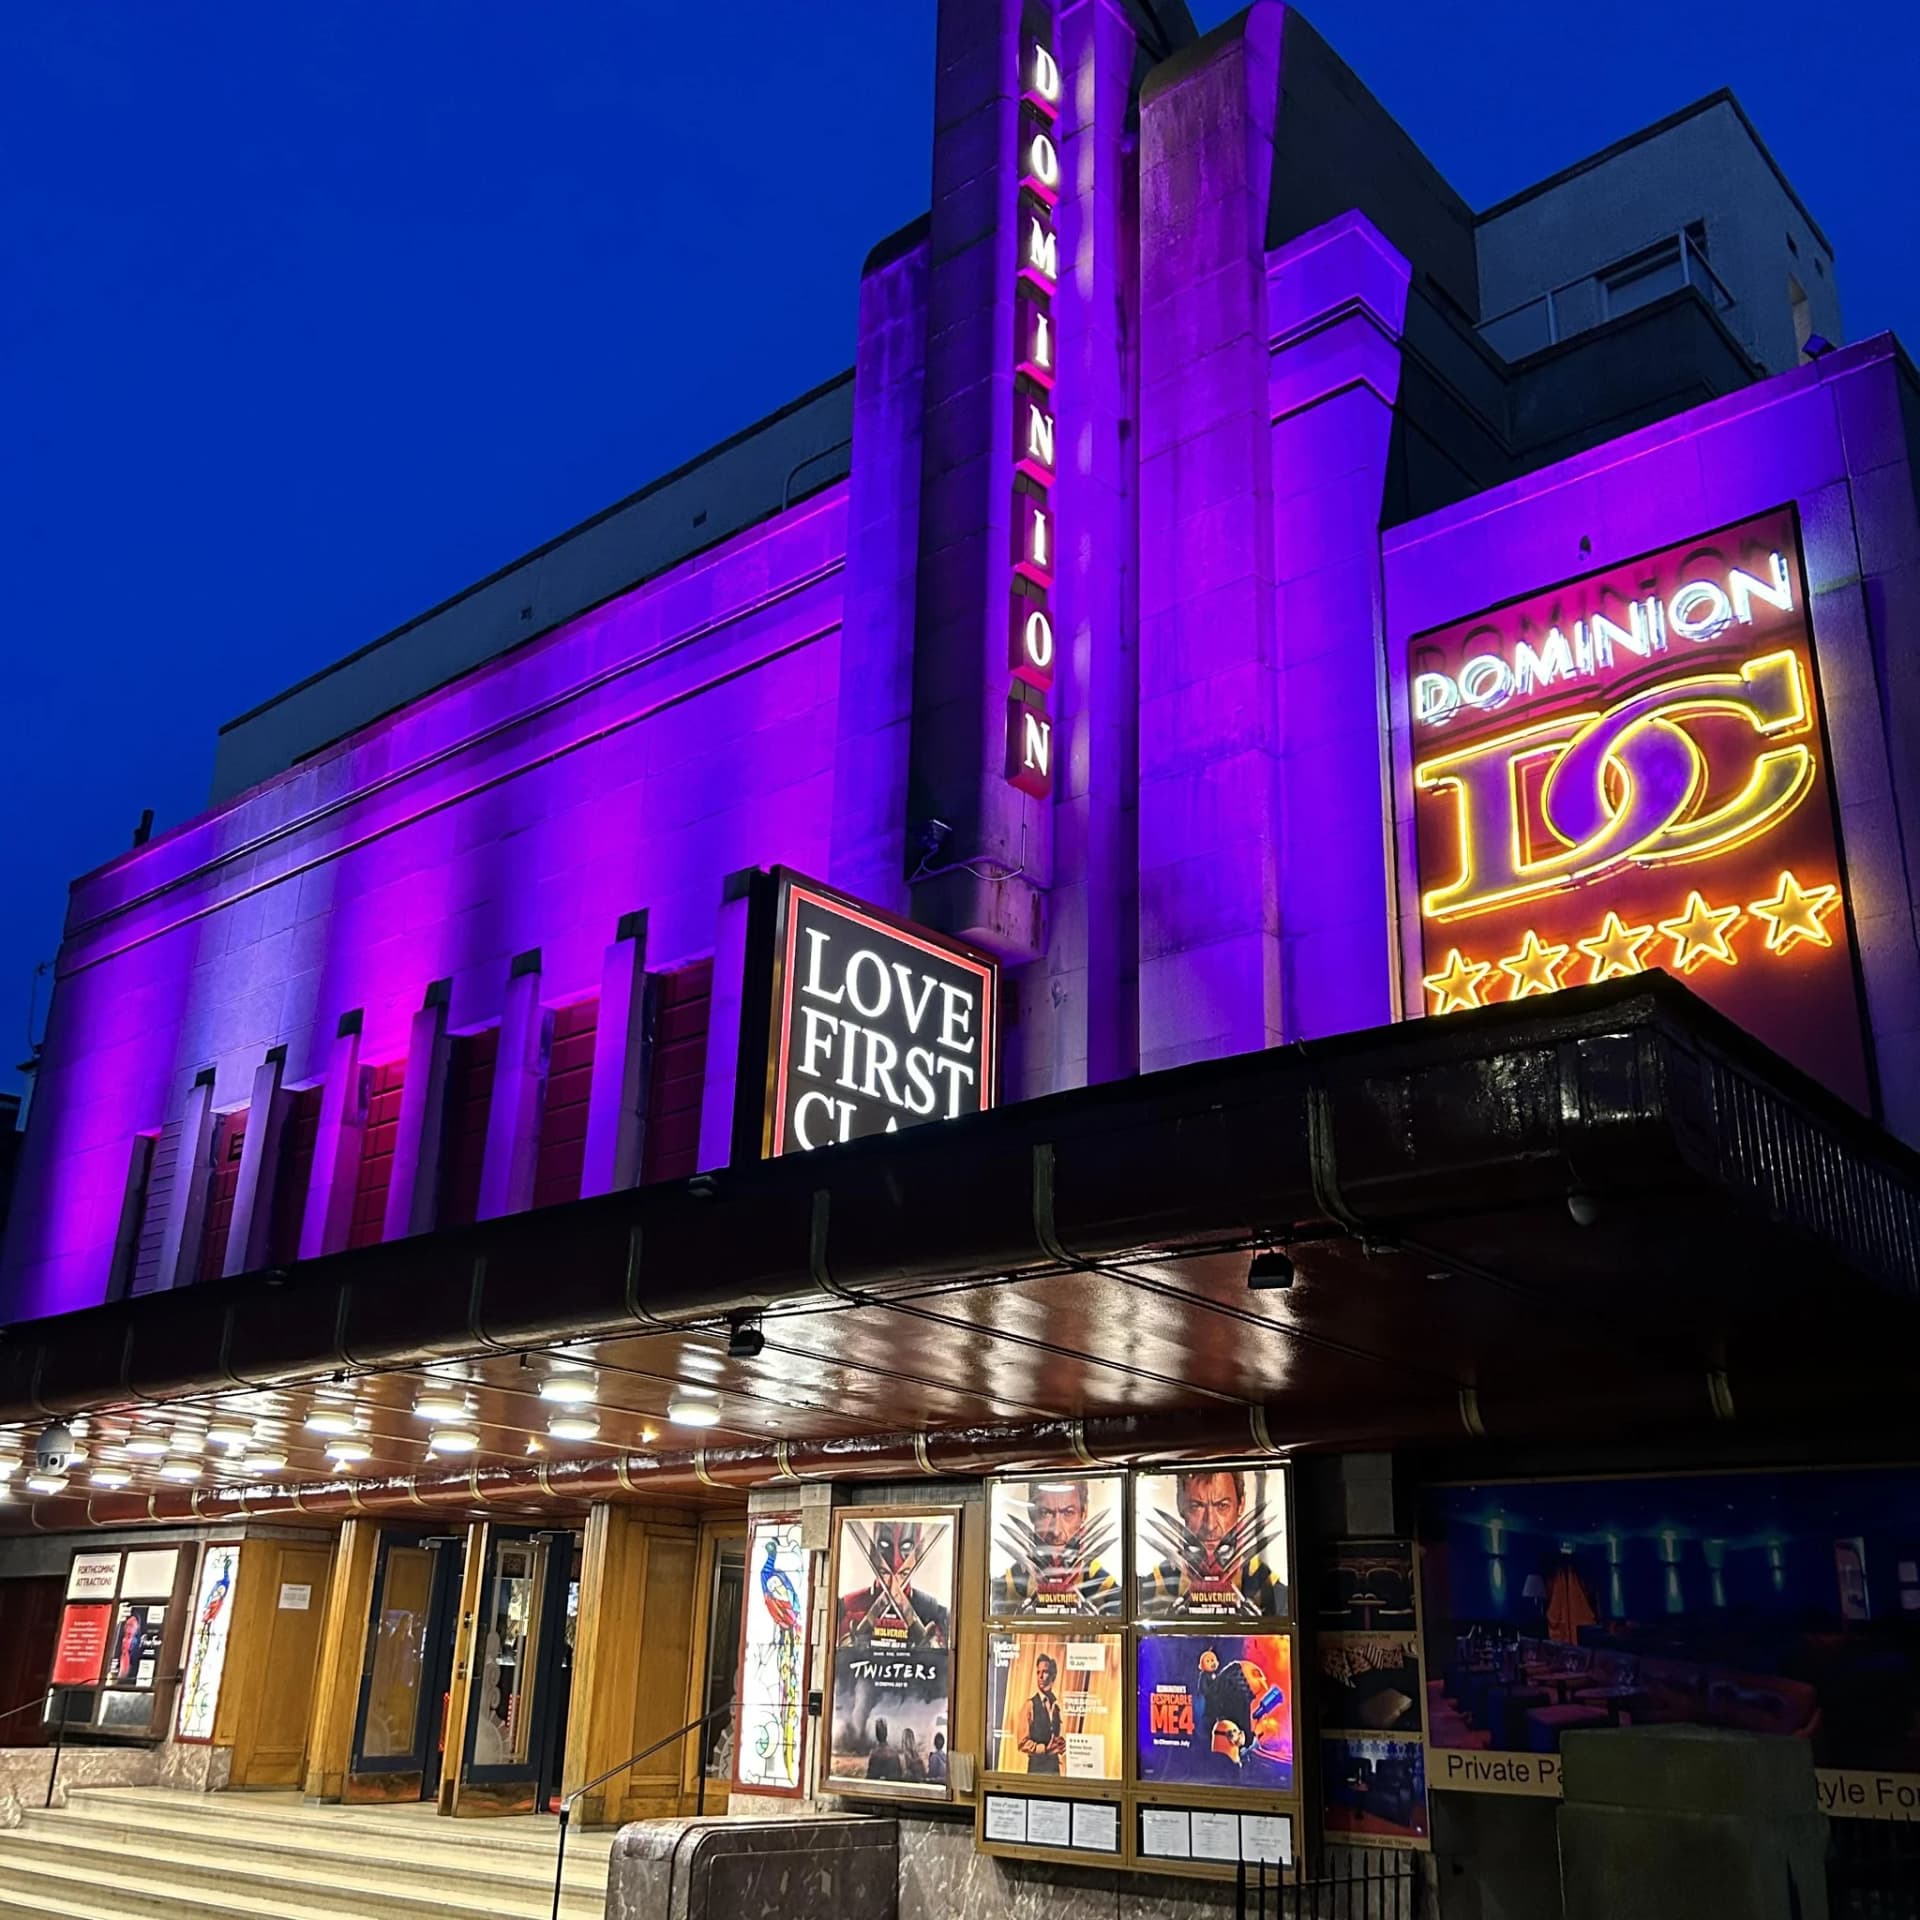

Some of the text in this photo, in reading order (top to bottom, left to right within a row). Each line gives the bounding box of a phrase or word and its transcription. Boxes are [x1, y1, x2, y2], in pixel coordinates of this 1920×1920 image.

[1024, 44, 1060, 776] DOMINION
[1416, 551, 1796, 725] DOMINION
[801, 927, 974, 1054] LOVE
[797, 1005, 975, 1120] FIRST
[77, 1564, 115, 1574] FORTHCOMING
[1190, 1592, 1237, 1602] WOLVERINE
[849, 1660, 937, 1681] TWISTERS
[1150, 1692, 1193, 1705] DESPICABLE
[1448, 1755, 1530, 1783] Private
